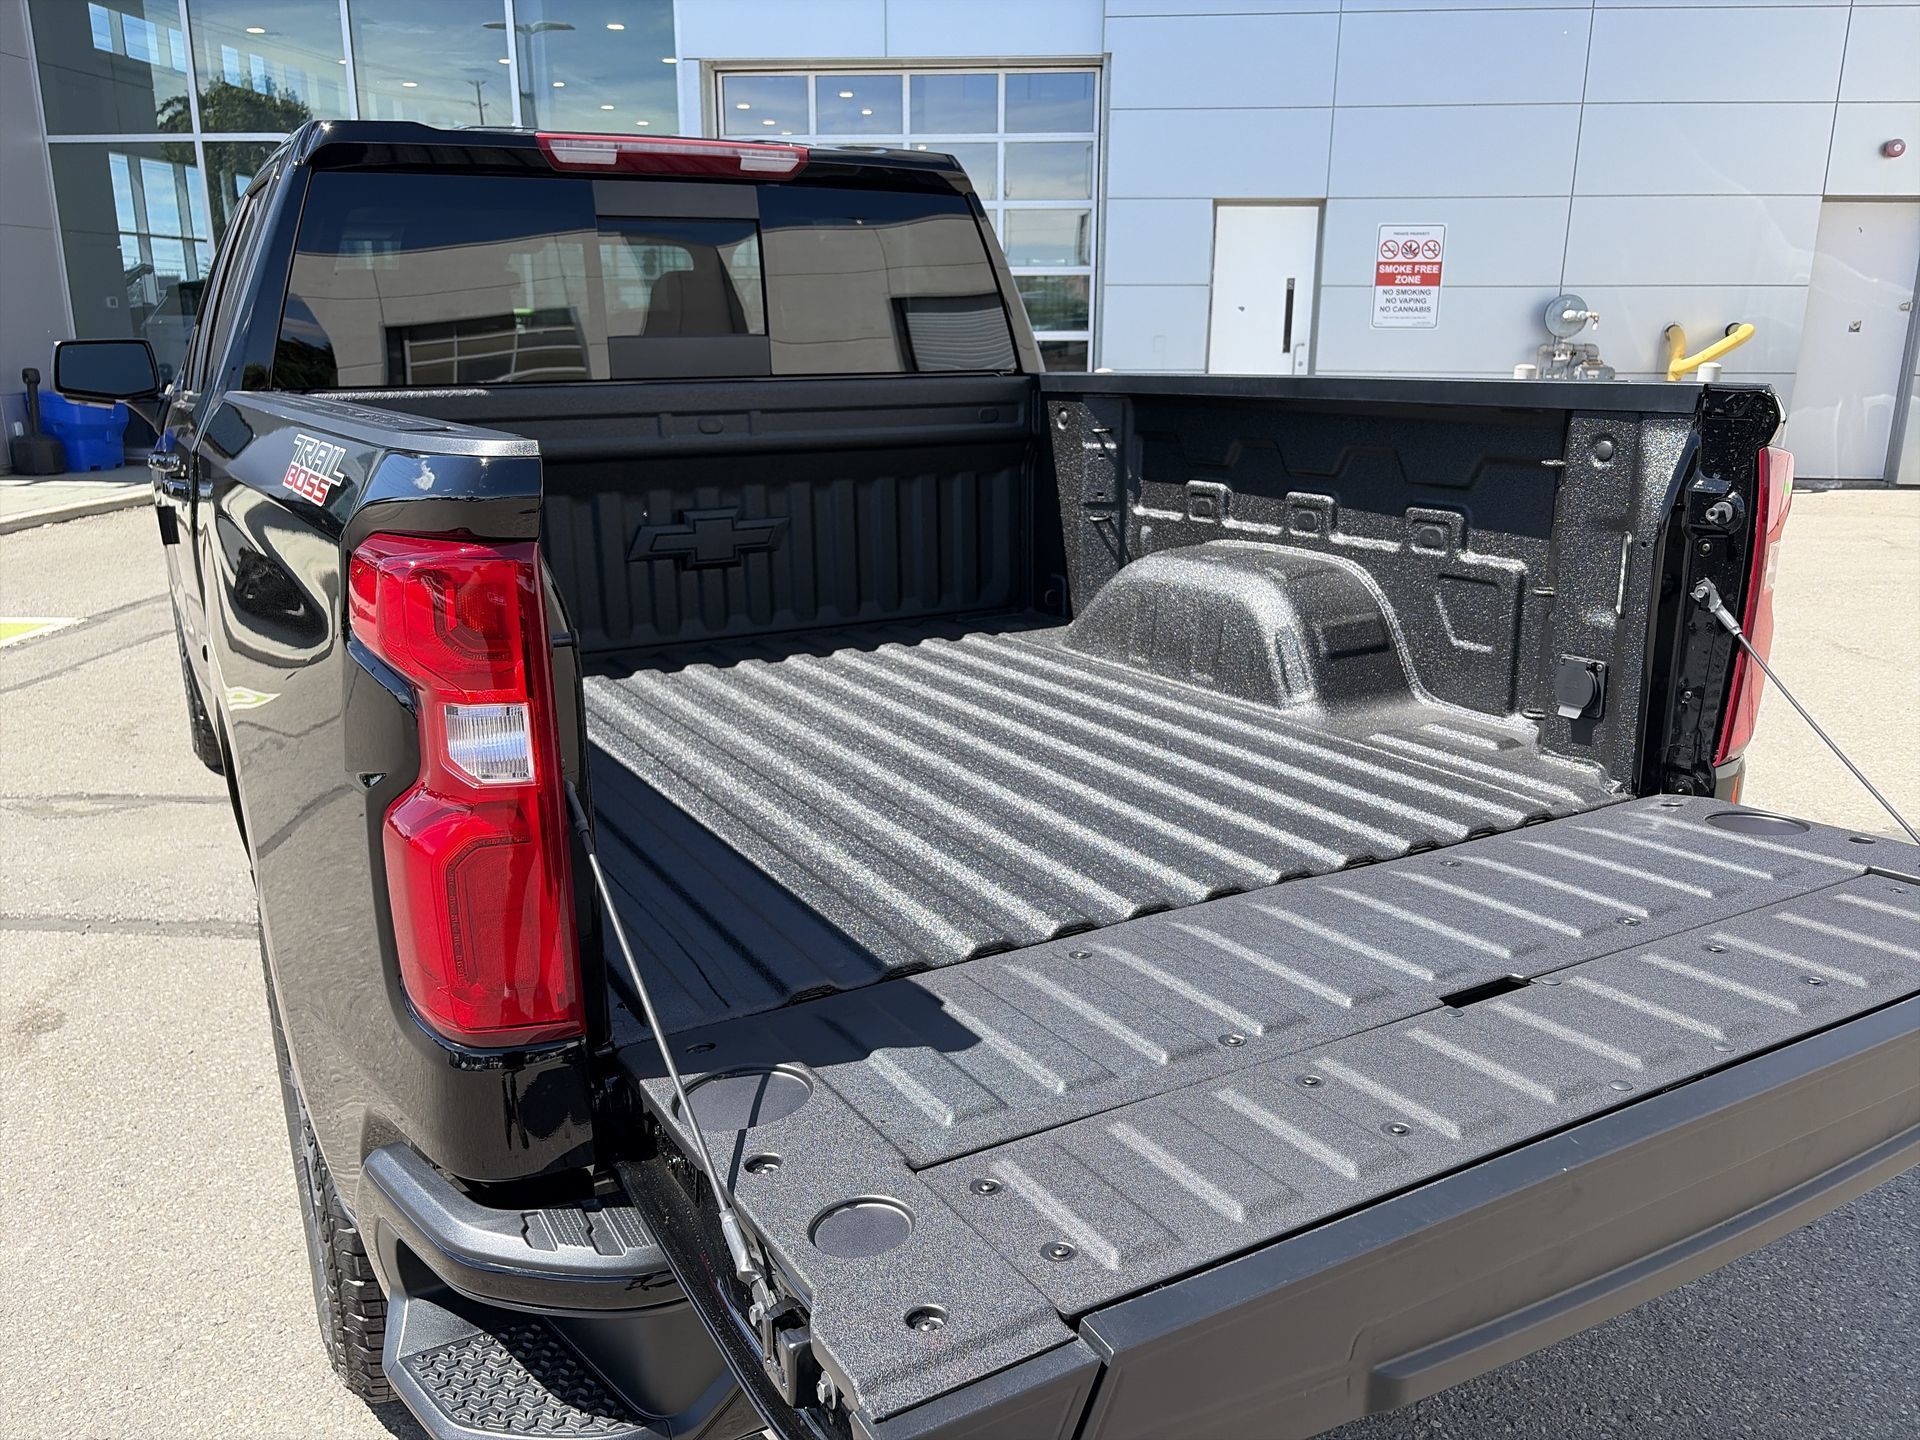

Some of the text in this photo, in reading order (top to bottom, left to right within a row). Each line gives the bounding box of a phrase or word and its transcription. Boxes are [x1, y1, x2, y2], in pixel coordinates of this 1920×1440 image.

[1379, 264, 1439, 274] SMOKE FREE
[1394, 275, 1421, 284] ZONE
[294, 434, 346, 487] TRAIL
[283, 463, 332, 507] BOSS
